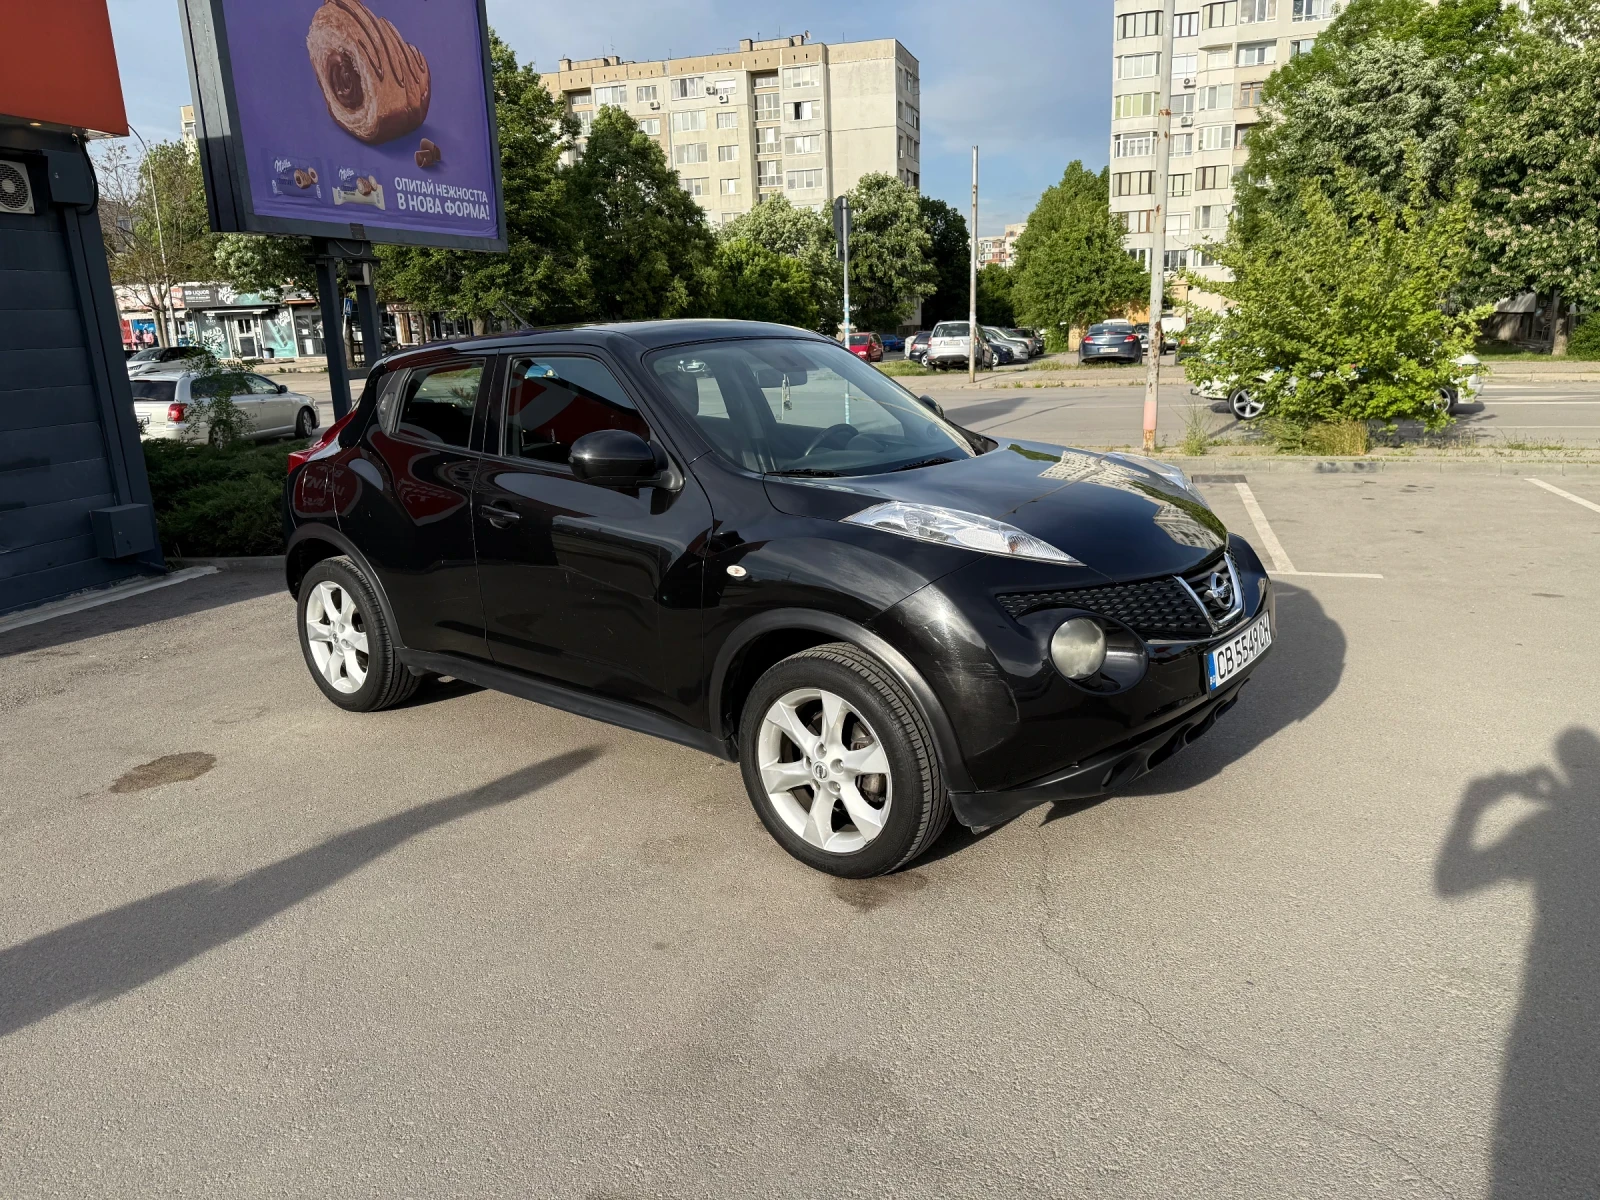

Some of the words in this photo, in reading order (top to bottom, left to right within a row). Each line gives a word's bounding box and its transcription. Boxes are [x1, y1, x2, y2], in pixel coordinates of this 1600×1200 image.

[274, 158, 291, 173] Milka
[339, 167, 354, 180] Milka
[394, 177, 435, 196] ОПИТАЙ
[435, 183, 488, 203] НЕЖНОСТТА
[397, 193, 406, 210] В
[408, 194, 443, 215] НОВА
[444, 200, 490, 221] ФОРМА!
[1217, 645, 1234, 680] CB
[1234, 627, 1258, 668] 5549
[1258, 615, 1270, 647] CH
